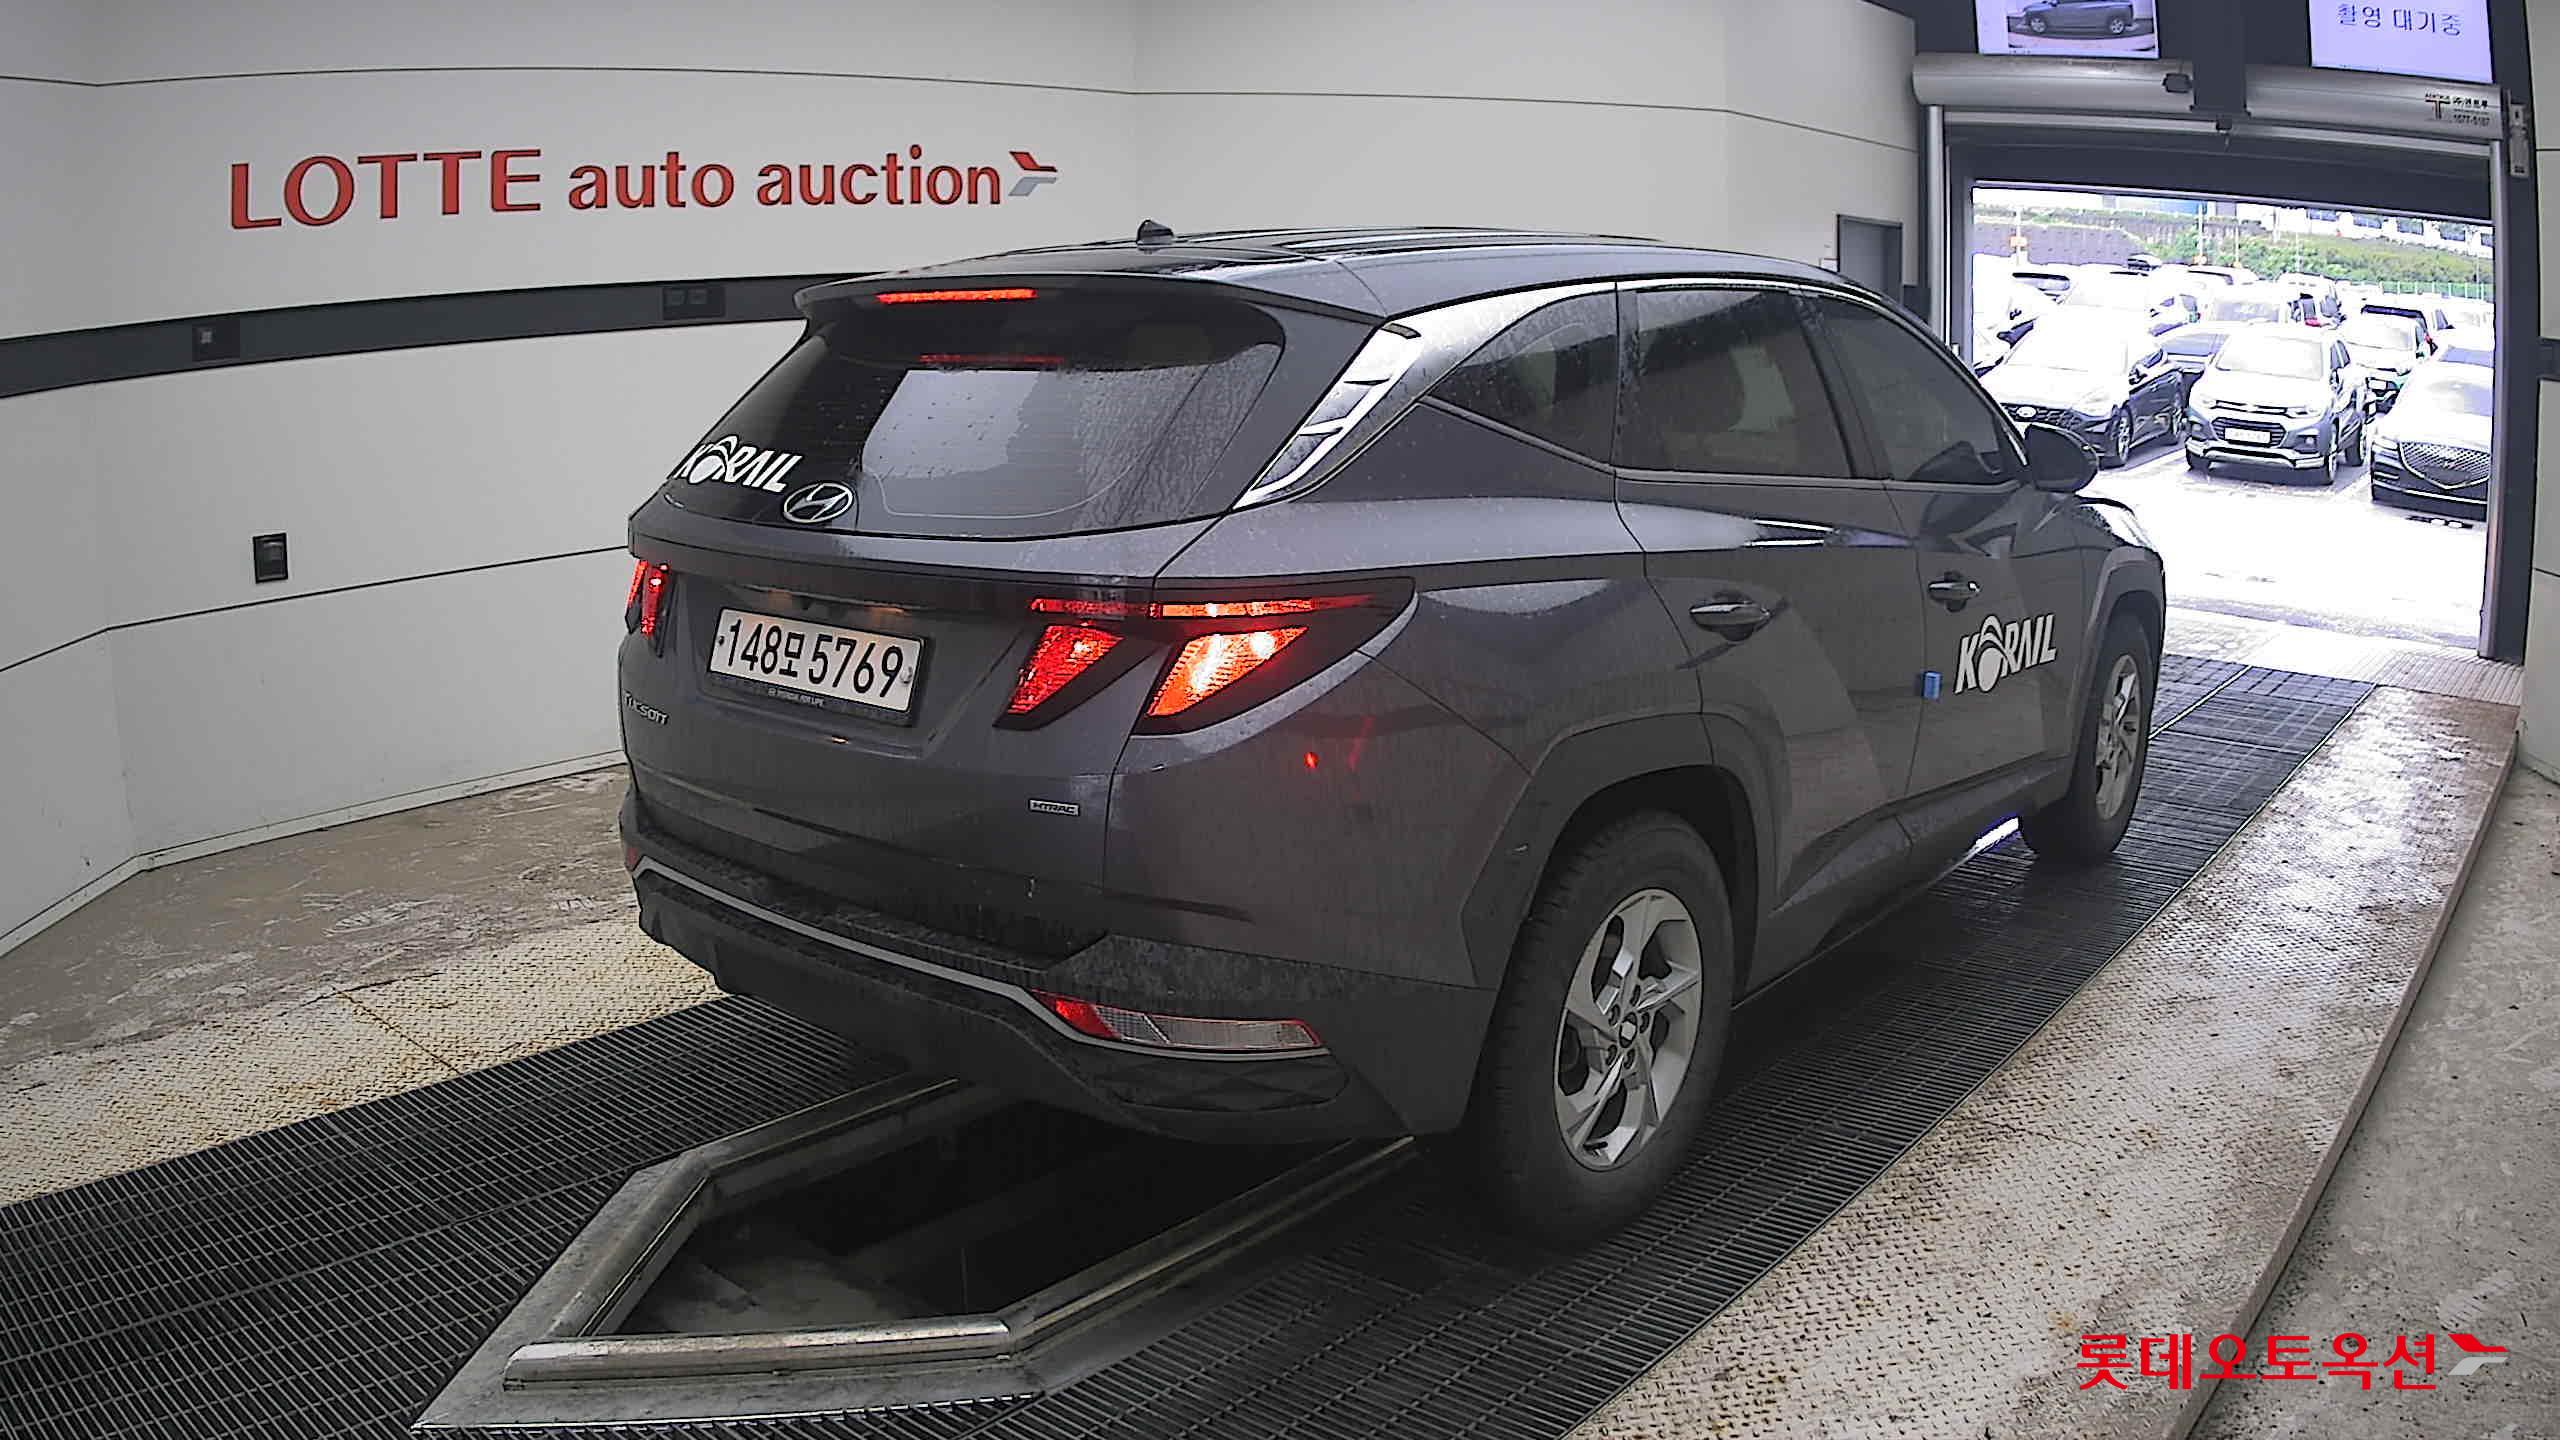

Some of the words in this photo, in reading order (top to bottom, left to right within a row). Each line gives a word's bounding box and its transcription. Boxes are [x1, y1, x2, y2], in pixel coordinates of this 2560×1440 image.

[2393, 9, 2462, 36] 대기중
[231, 149, 539, 228] LOTTE
[568, 153, 734, 209] auto
[757, 146, 1000, 205] auction
[672, 435, 803, 493] KORAIL
[1954, 614, 2058, 694] KORAIL
